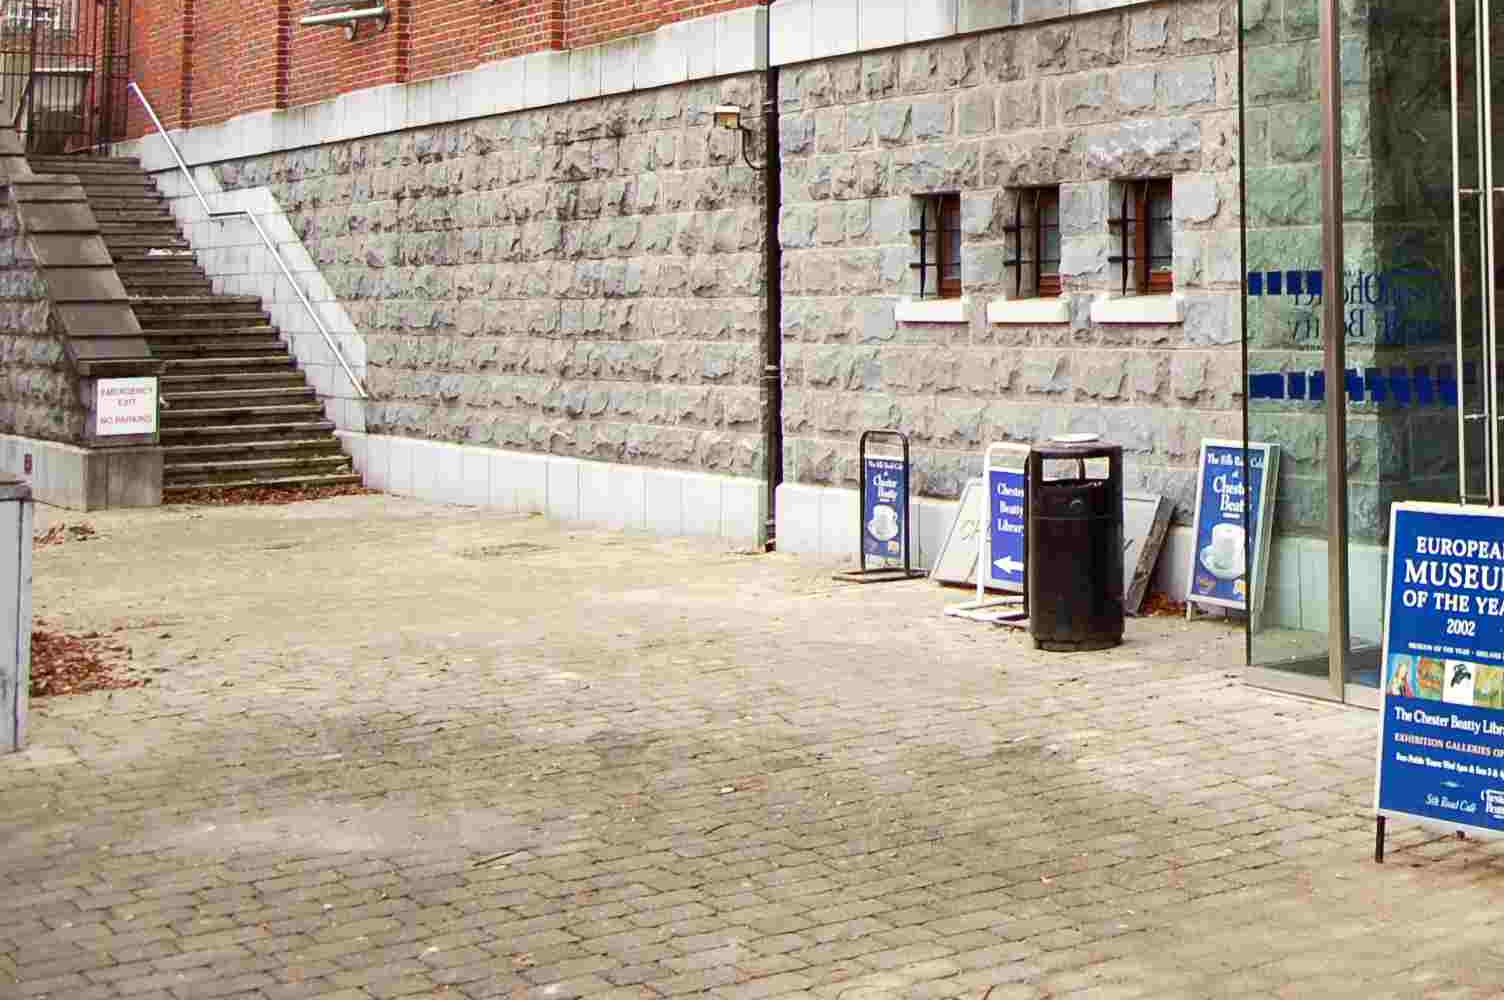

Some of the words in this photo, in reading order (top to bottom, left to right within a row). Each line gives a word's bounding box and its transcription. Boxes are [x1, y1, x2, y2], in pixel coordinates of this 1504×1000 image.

[1402, 589, 1429, 608] OF
[1432, 592, 1470, 613] THE
[1446, 618, 1476, 636] 2002
[1394, 705, 1413, 720] The
[1413, 709, 1450, 728] Chester
[1450, 715, 1482, 735] Beatty
[1394, 732, 1444, 749] EXHIBITION
[1445, 740, 1492, 757] GALLERIES
